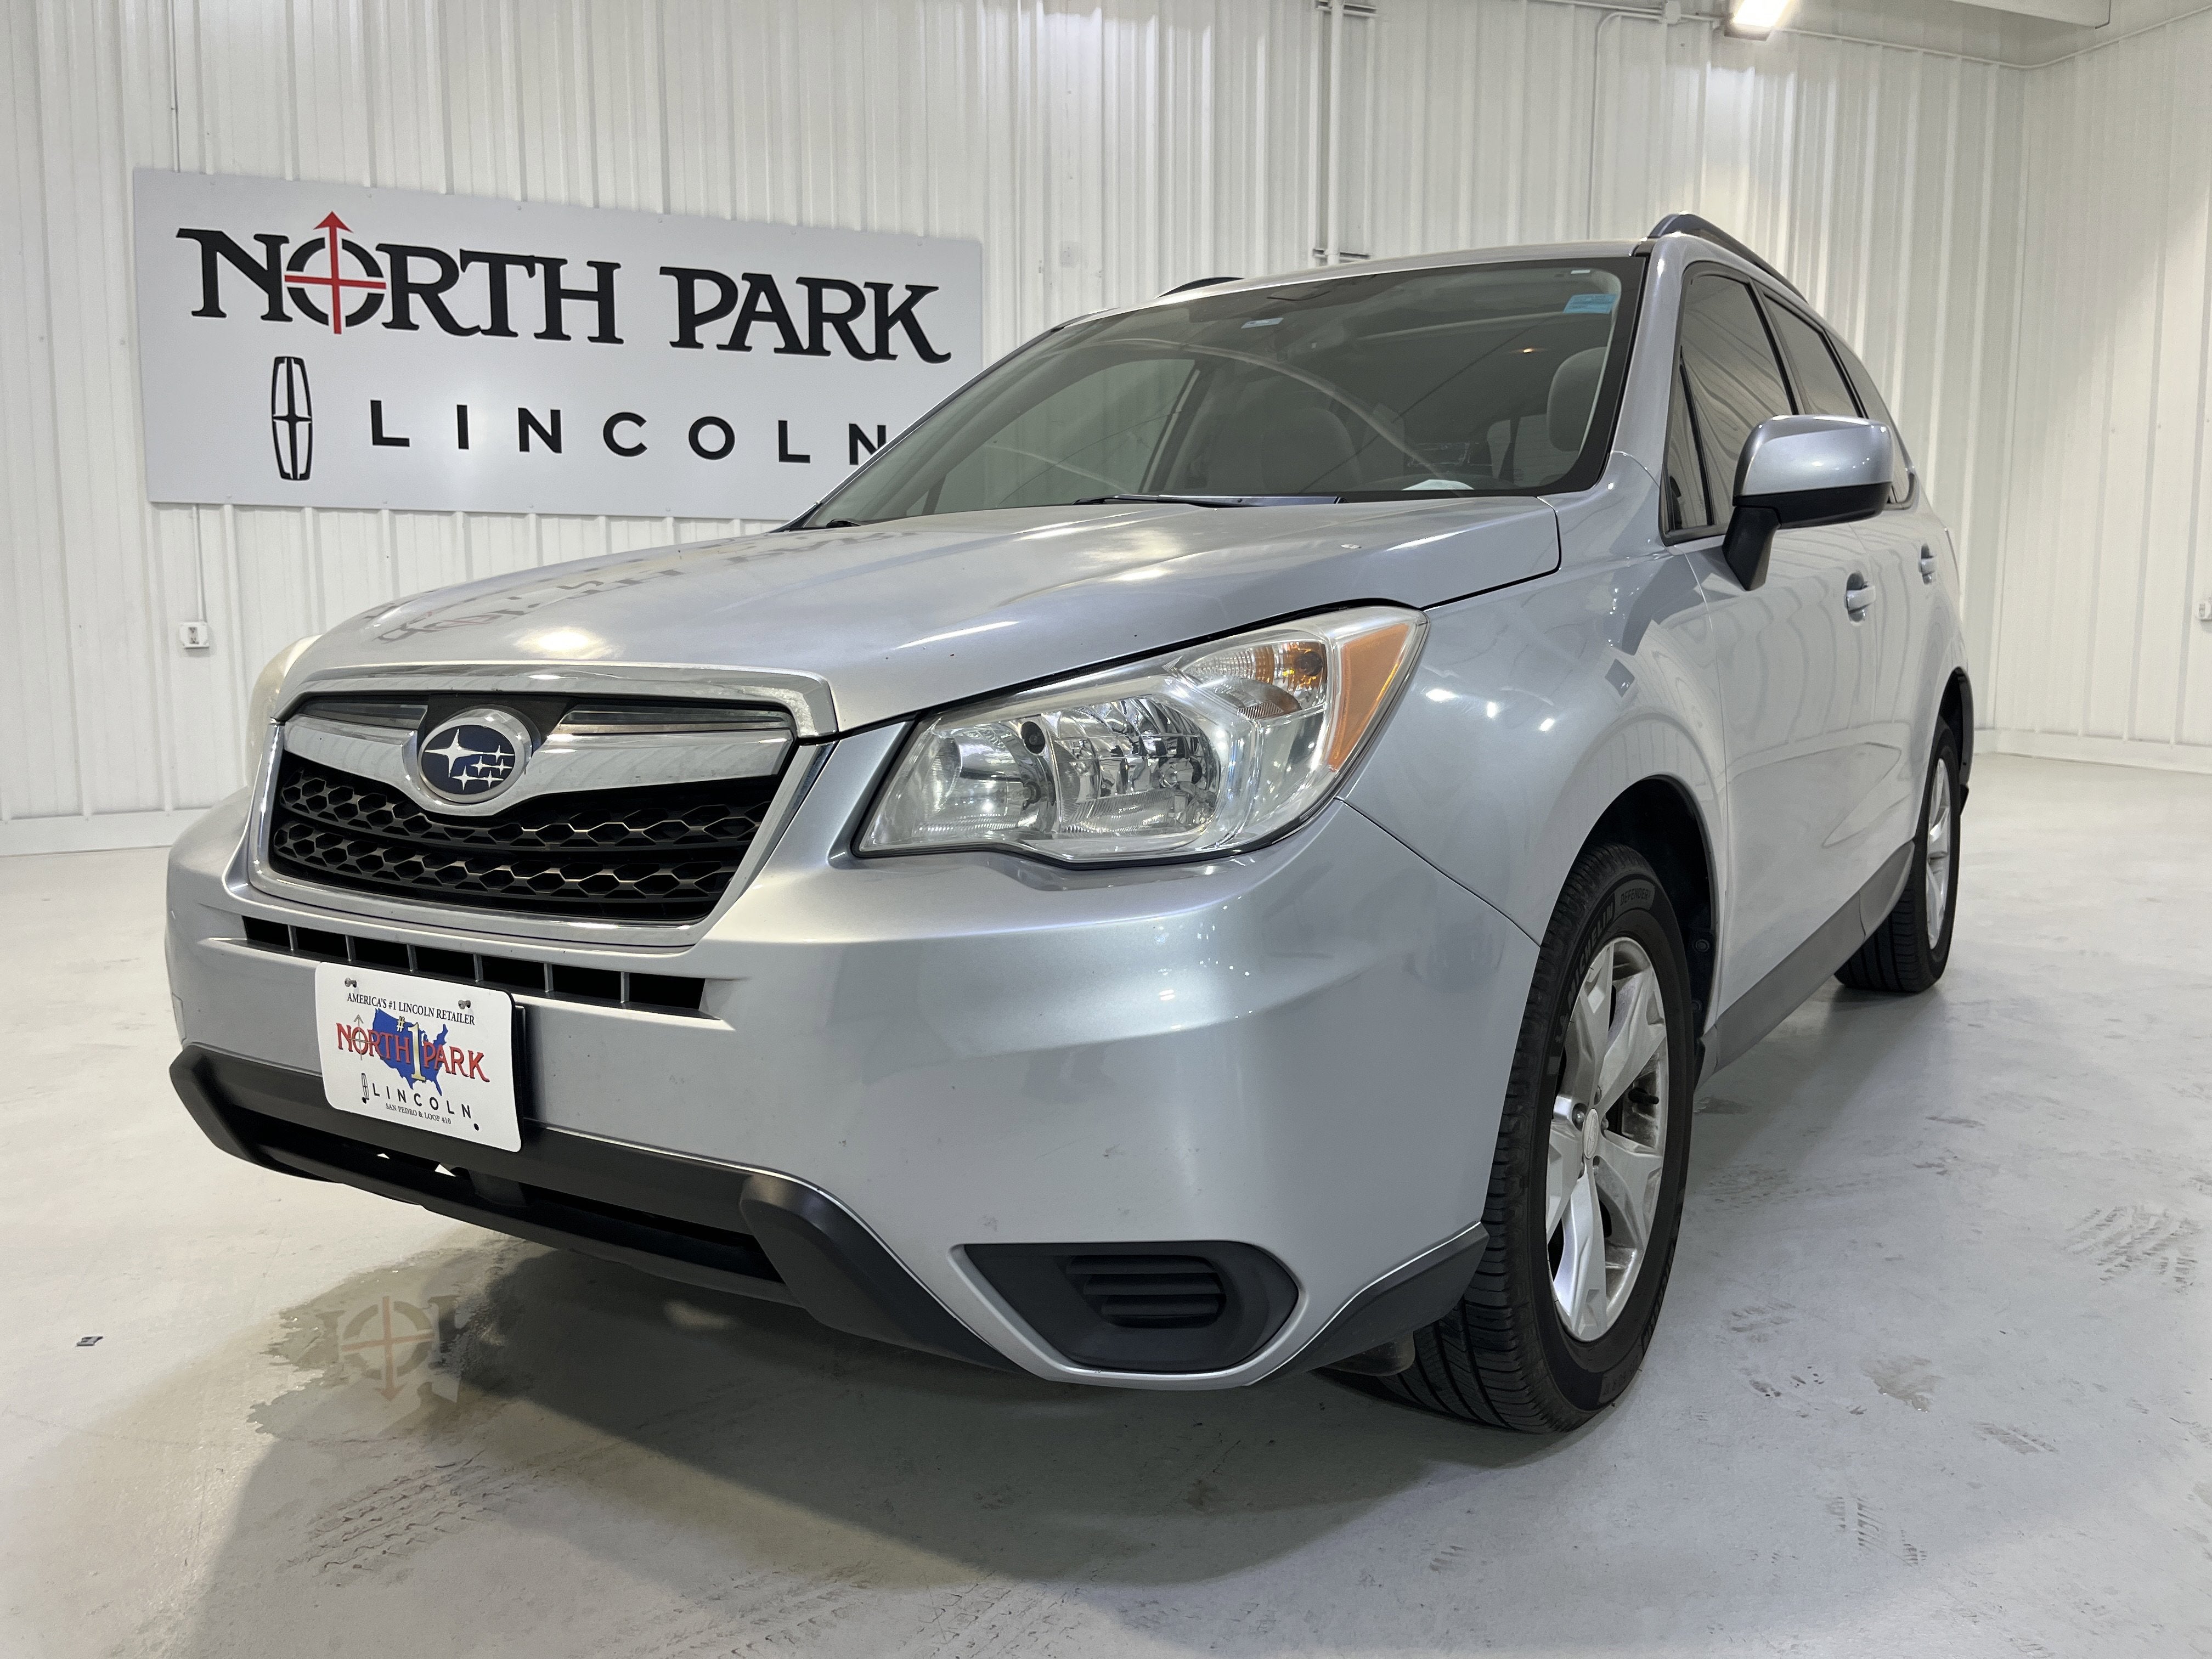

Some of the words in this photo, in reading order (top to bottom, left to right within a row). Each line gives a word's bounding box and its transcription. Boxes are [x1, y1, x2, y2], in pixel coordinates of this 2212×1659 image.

[176, 226, 624, 345] NORTH
[659, 266, 951, 364] PARK
[370, 399, 887, 465] LINCOLN
[1567, 901, 1614, 1010] MICHELIN
[347, 992, 387, 1008] AMERICA'S
[388, 1000, 396, 1010] #1
[398, 1001, 435, 1018] LINCOLN
[436, 1008, 475, 1025] RETAILER
[336, 1022, 410, 1064] NORTH
[422, 1040, 490, 1082] PARK
[373, 1083, 471, 1119] LINCOLN
[385, 1103, 396, 1111] SAN
[398, 1106, 417, 1116] PEDRO
[424, 1113, 440, 1122] LOOP
